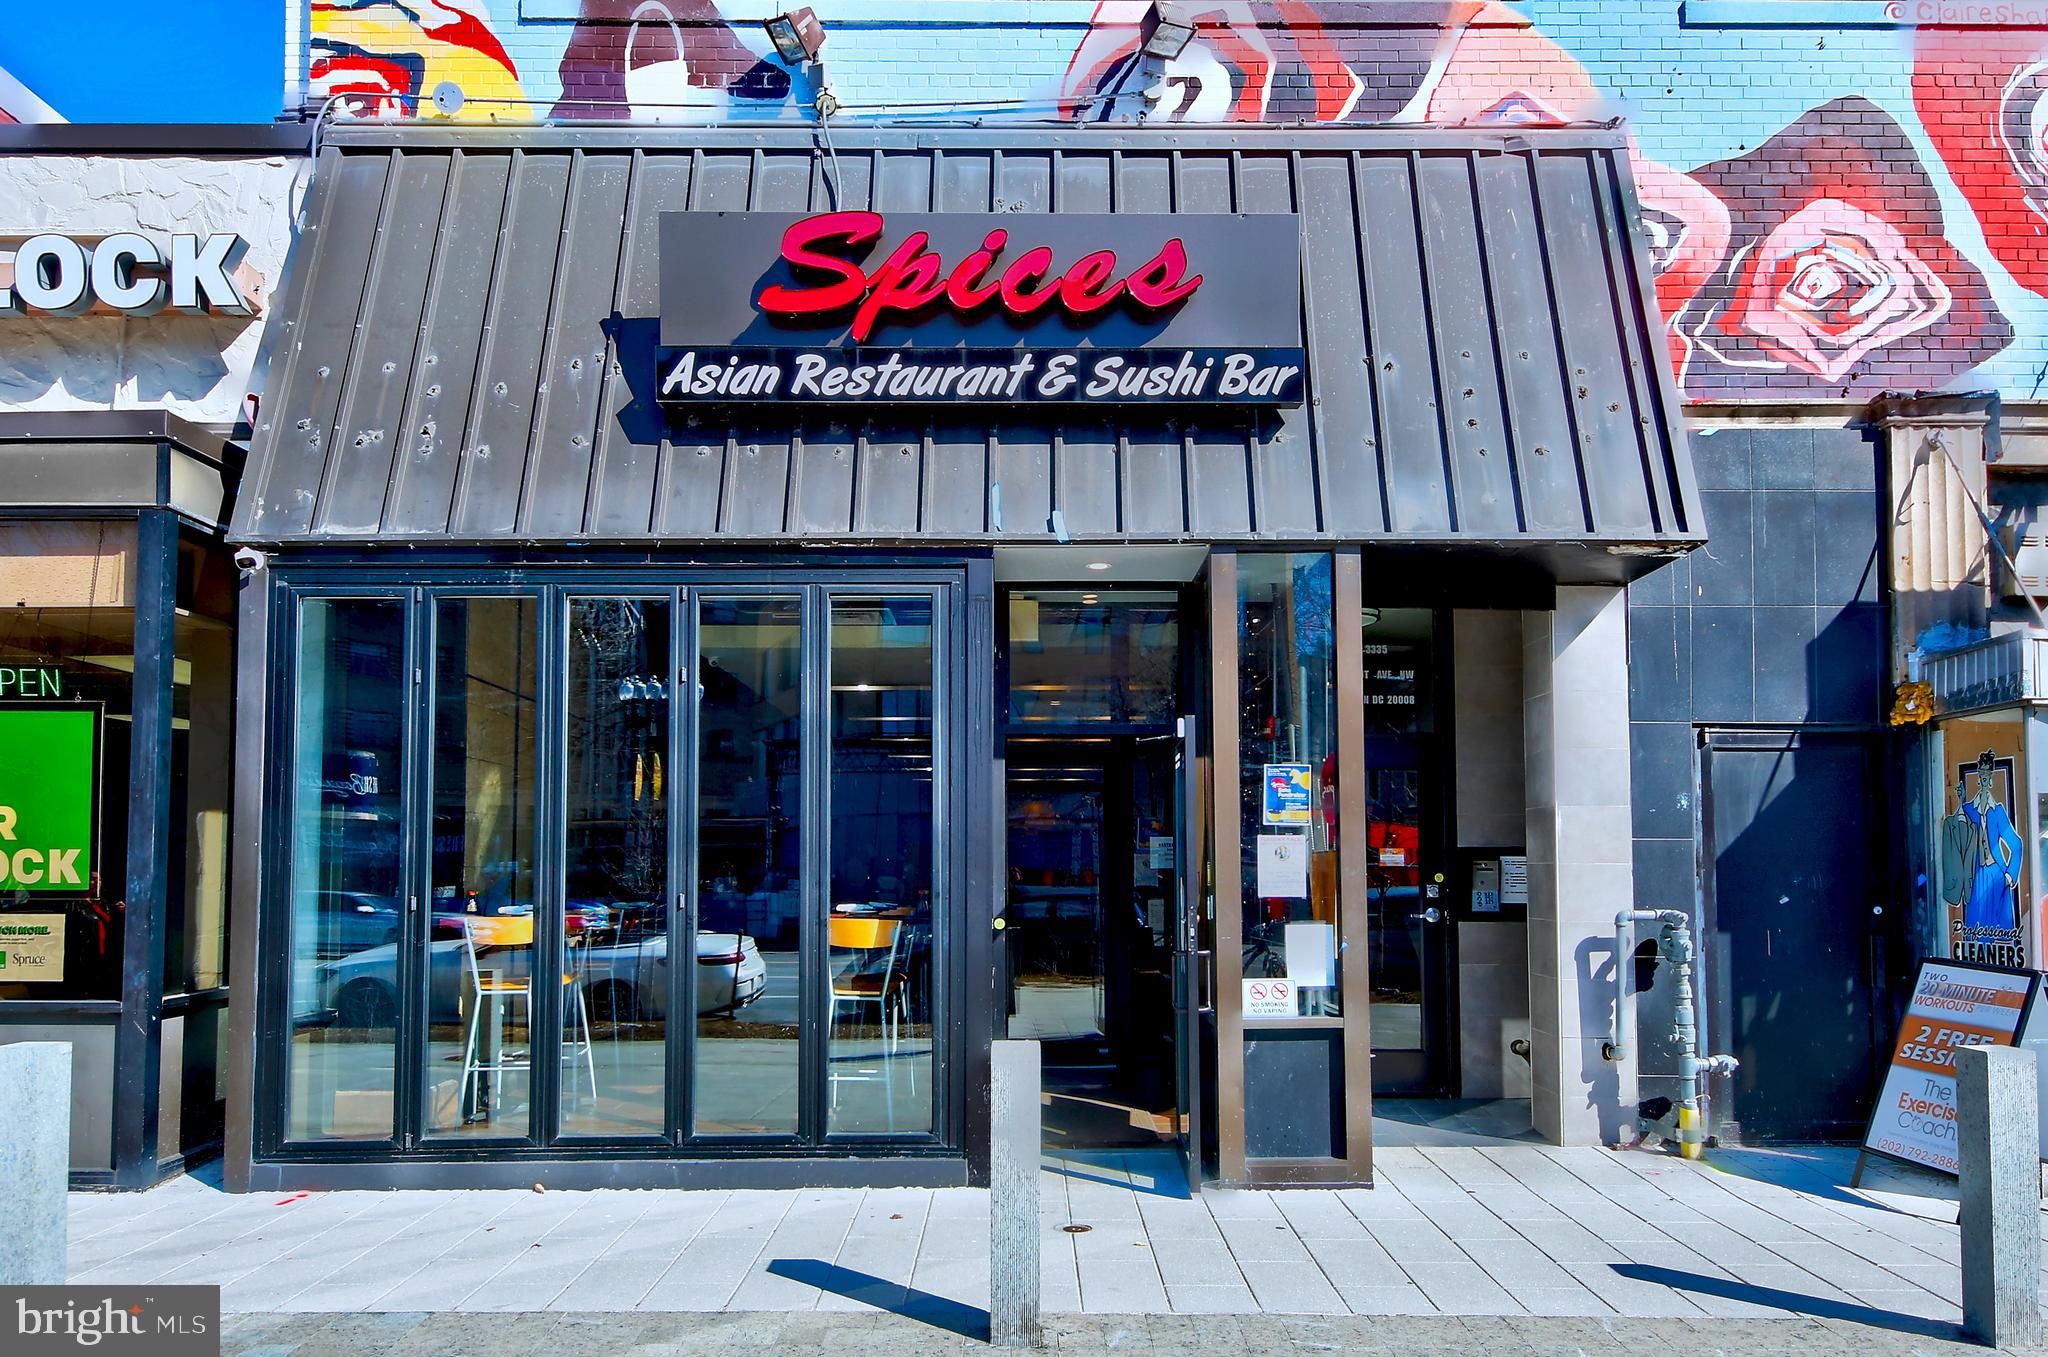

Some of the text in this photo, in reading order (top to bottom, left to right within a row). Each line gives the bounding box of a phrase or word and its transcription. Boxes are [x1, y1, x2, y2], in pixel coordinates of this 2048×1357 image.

[0, 233, 243, 309] OCK
[757, 211, 1203, 344] Spices
[661, 351, 1299, 397] Asian Restaurant & Sushi Bar
[1373, 695, 1384, 705] DC
[1387, 695, 1415, 705] 20008
[0, 848, 82, 885] CK
[1952, 919, 2025, 941] Professional
[12, 952, 46, 967] Spruce
[1953, 941, 2026, 969] CLEANERS
[1923, 972, 1949, 982] TWO
[1914, 995, 1975, 1014] WORKOUTS
[1914, 1025, 1932, 1043] 2
[1924, 1078, 1952, 1101] The
[1876, 1137, 1906, 1156] (202)
